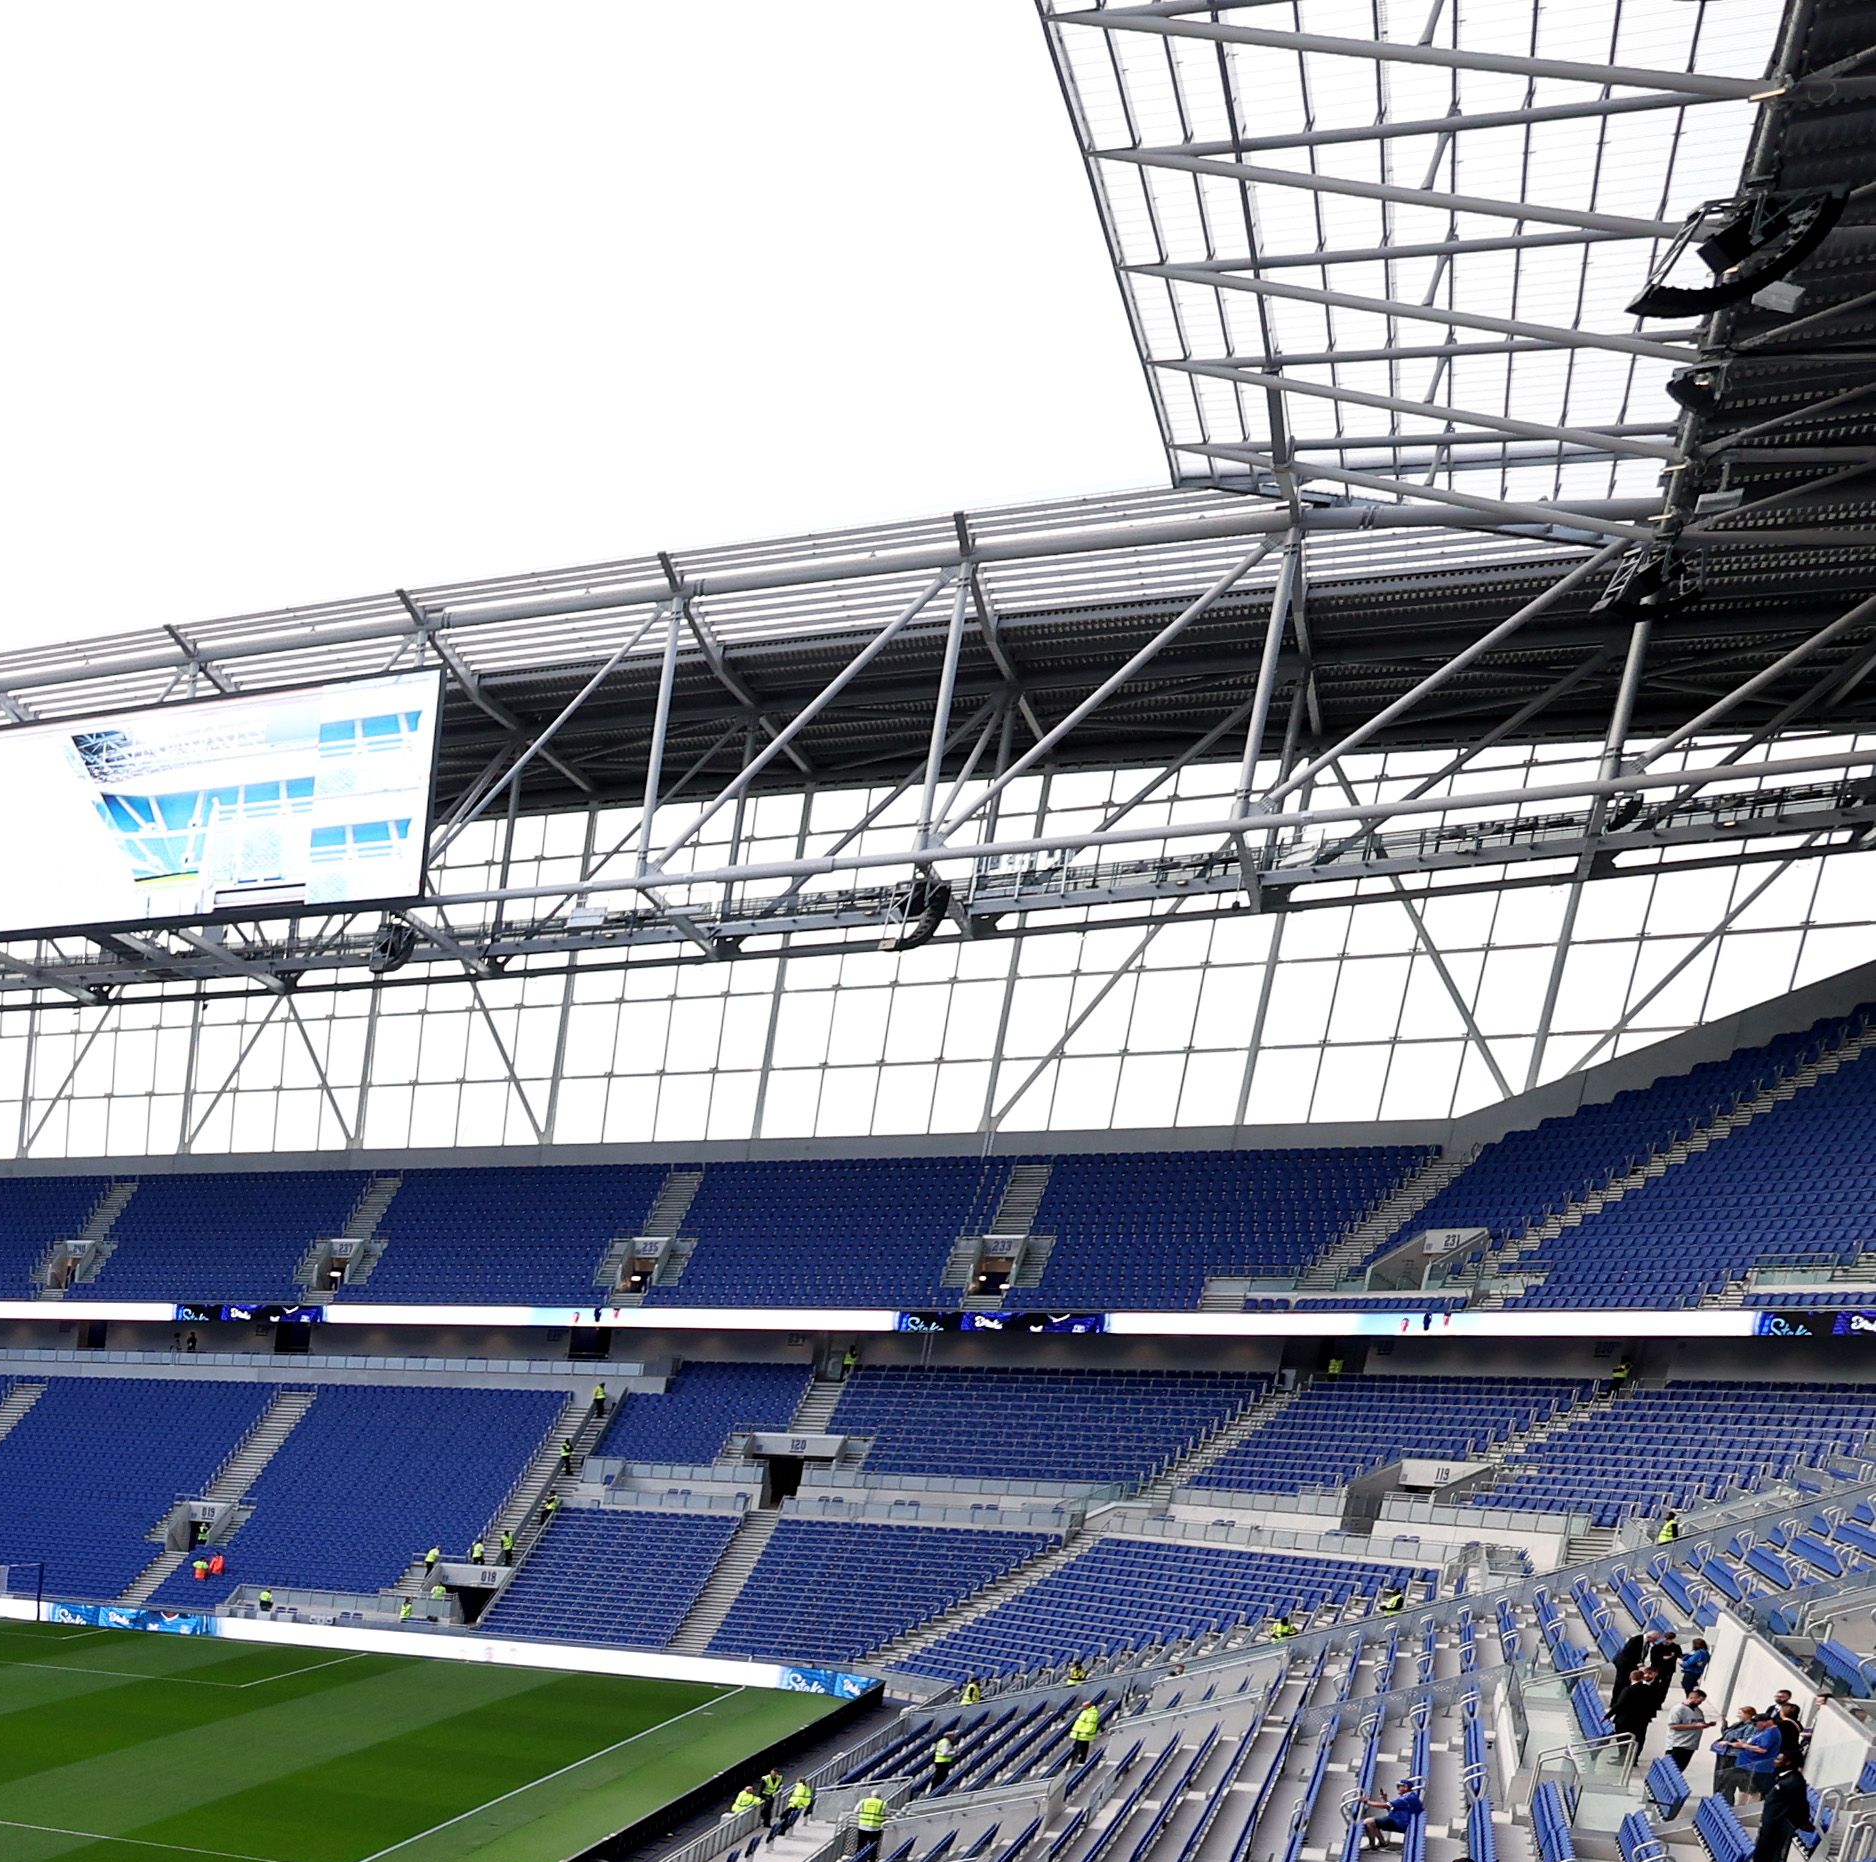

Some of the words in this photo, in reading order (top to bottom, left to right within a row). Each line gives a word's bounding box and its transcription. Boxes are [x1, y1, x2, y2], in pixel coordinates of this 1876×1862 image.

[1444, 1234, 1460, 1247] 231
[339, 1244, 353, 1253] 237
[642, 1242, 659, 1252] 235
[992, 1241, 1012, 1252] 233
[791, 1439, 807, 1450] 120
[1436, 1467, 1450, 1480] 119
[201, 1507, 215, 1517] 019
[481, 1571, 497, 1582] 018
